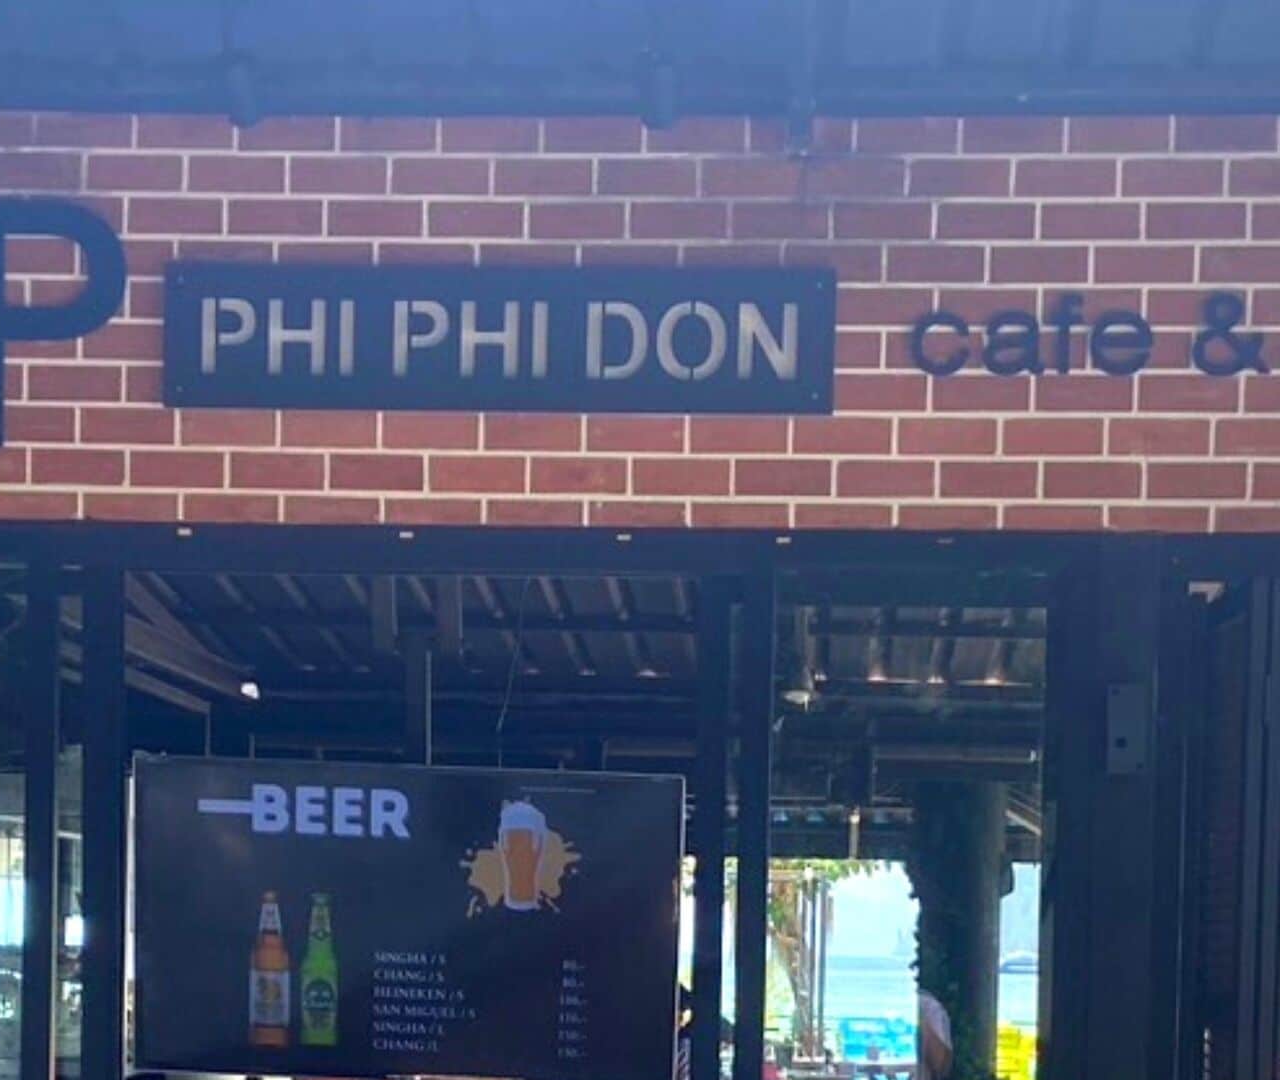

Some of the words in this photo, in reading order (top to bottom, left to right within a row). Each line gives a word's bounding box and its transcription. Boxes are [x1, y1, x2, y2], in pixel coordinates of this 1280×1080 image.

[201, 297, 353, 376] PHI
[393, 299, 548, 378] PHI
[584, 300, 798, 381] DON
[909, 293, 1154, 378] cafe
[1190, 290, 1270, 378] &
[252, 783, 411, 839] BEER
